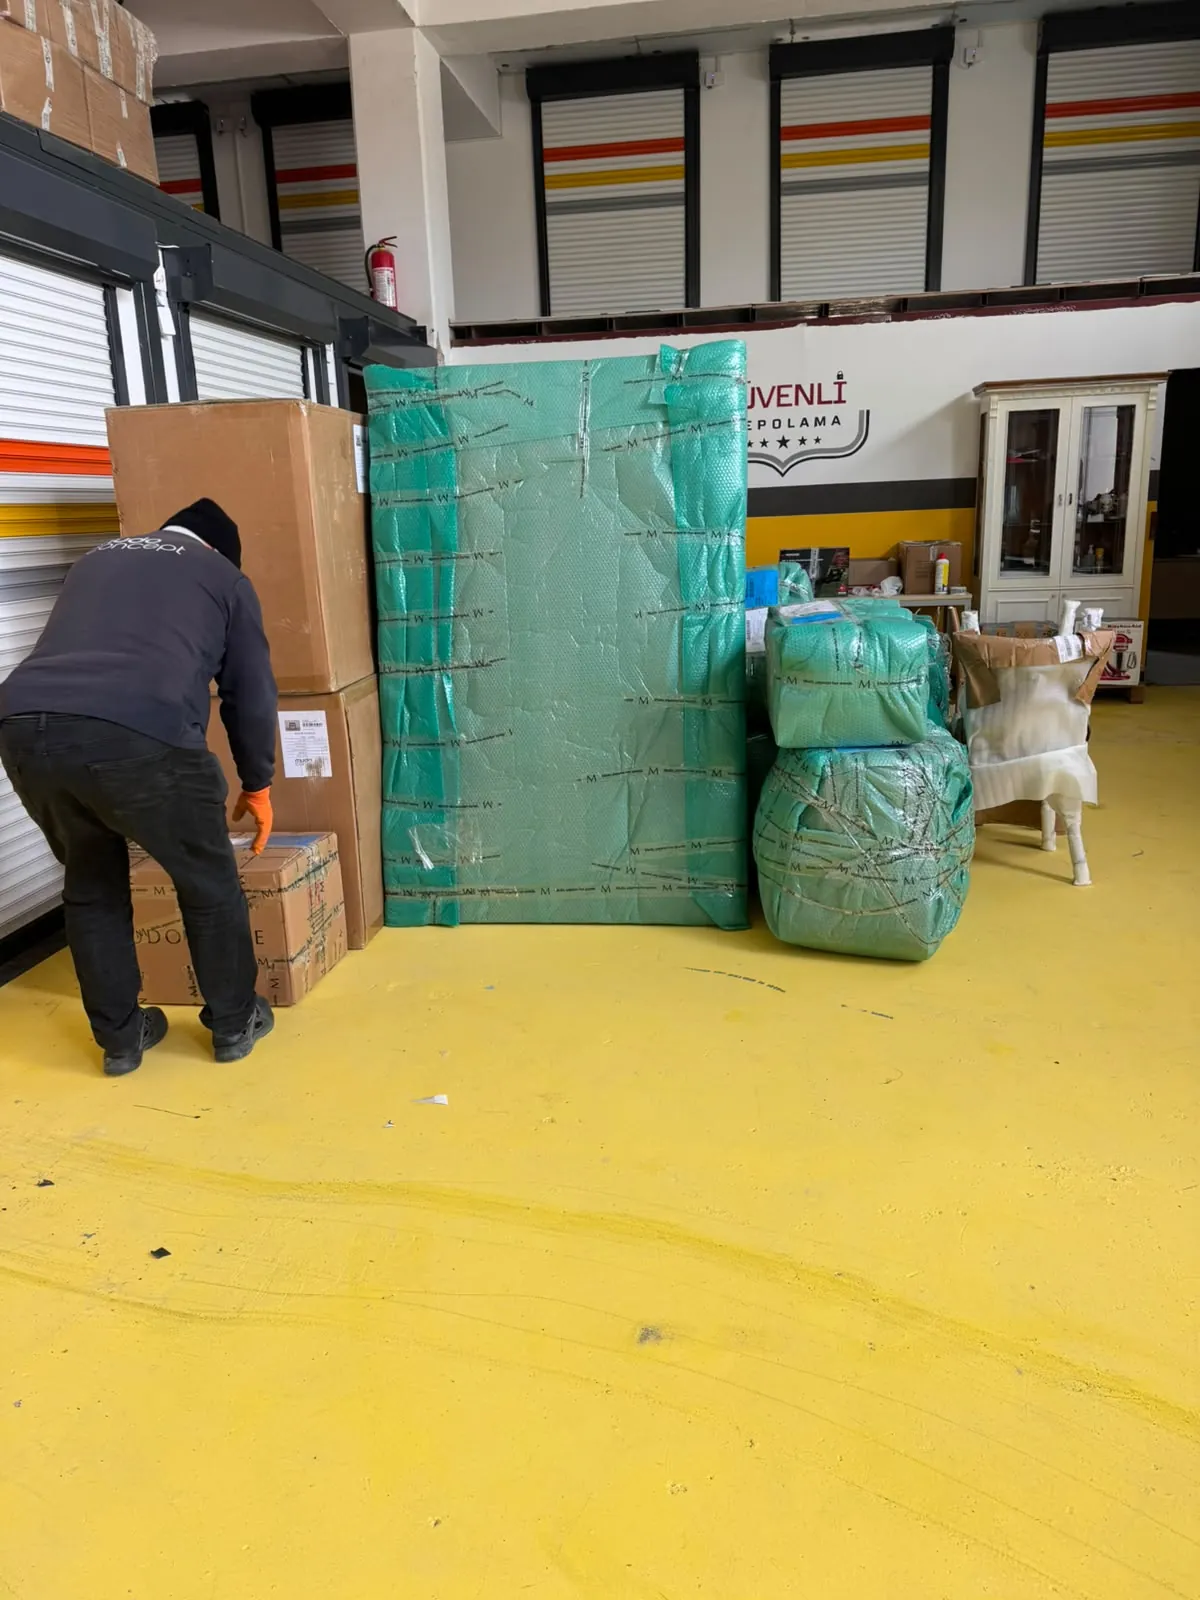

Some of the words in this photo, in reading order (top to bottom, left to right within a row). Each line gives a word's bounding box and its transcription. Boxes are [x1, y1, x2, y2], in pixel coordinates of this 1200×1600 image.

[647, 530, 658, 538] M
[711, 531, 722, 539] M
[108, 537, 162, 546] udo
[786, 676, 798, 685] M
[859, 680, 871, 689] M
[639, 697, 649, 705] M
[703, 698, 713, 706] M
[586, 775, 597, 783] M
[648, 768, 659, 776] M
[712, 769, 722, 777] M
[630, 847, 640, 856] M
[691, 841, 702, 849] M
[904, 877, 915, 886] M
[154, 887, 165, 895] M
[262, 890, 273, 899] M
[540, 888, 551, 896] M
[601, 885, 611, 893] M
[662, 884, 673, 892] M
